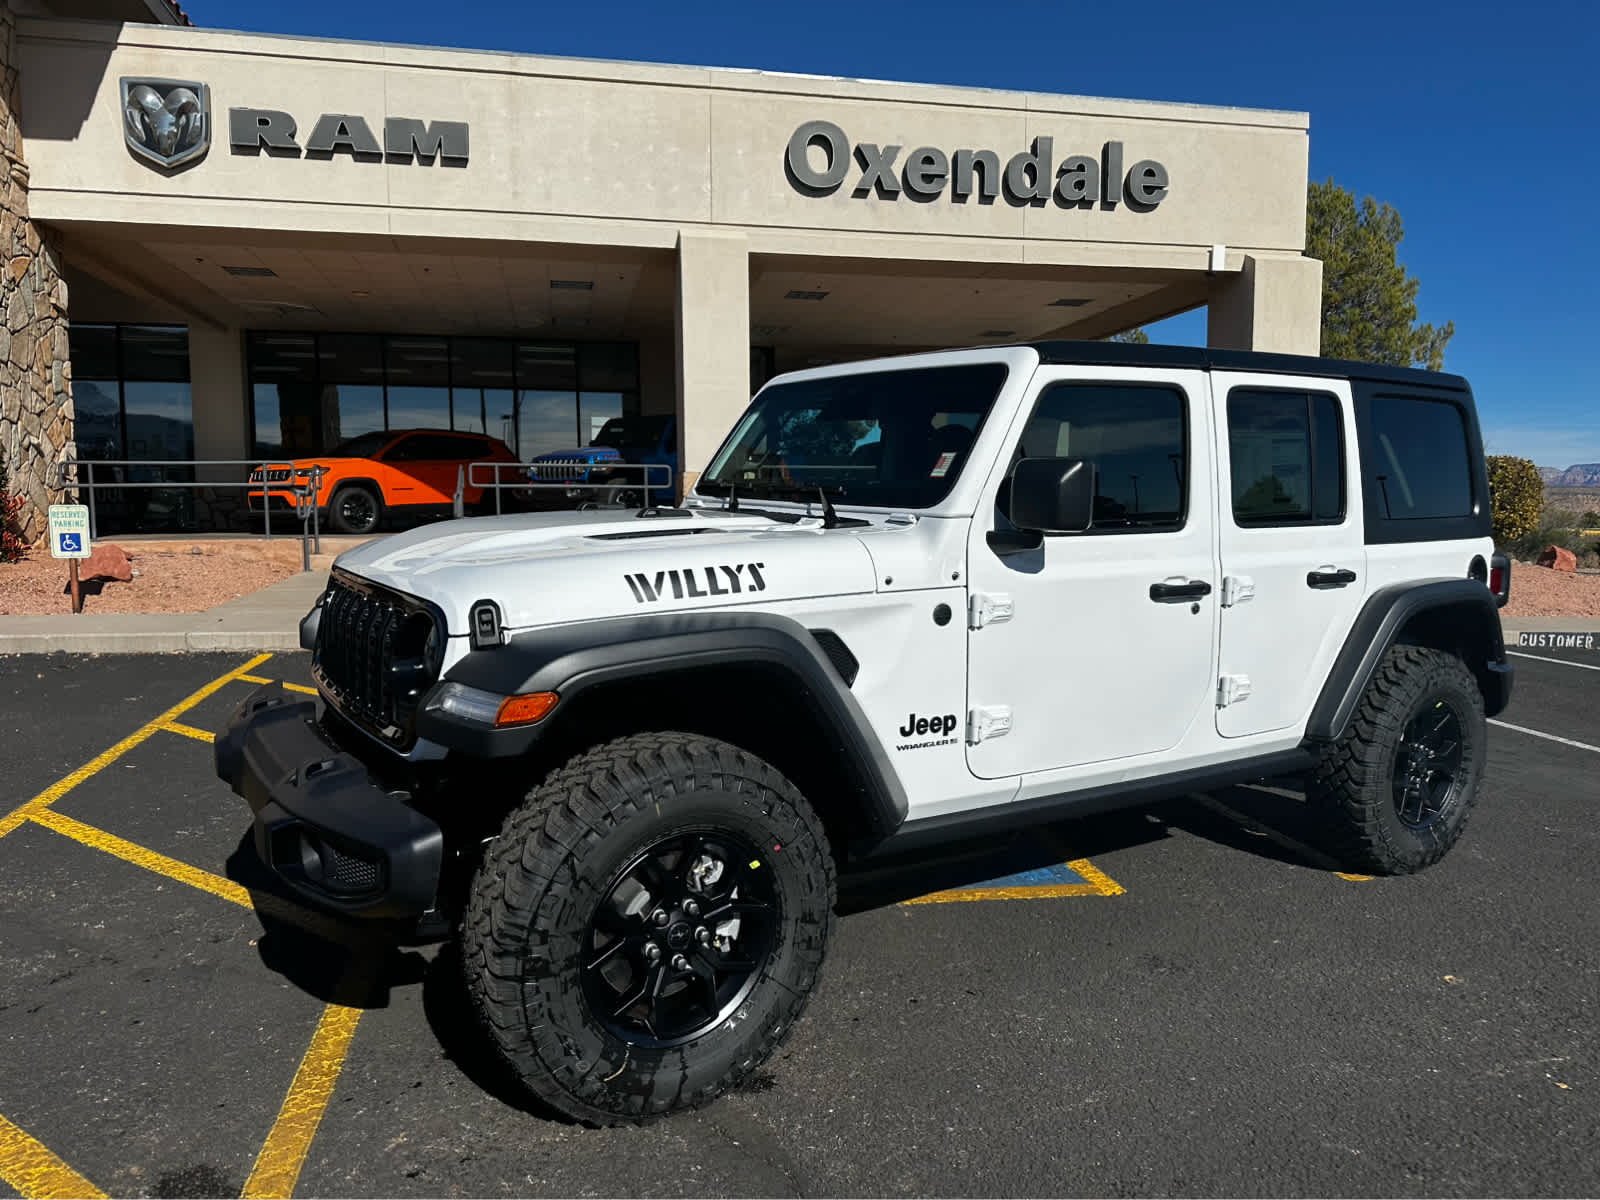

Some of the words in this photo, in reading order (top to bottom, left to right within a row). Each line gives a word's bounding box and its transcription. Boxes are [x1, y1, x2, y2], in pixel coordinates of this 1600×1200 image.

[229, 107, 469, 168] RAM
[784, 120, 1169, 213] Oxendale
[54, 520, 84, 528] PARKING
[623, 562, 766, 603] WILLYS
[1520, 633, 1594, 649] CUSTOMER
[900, 713, 957, 737] Jeep
[896, 739, 949, 751] WRANGLER
